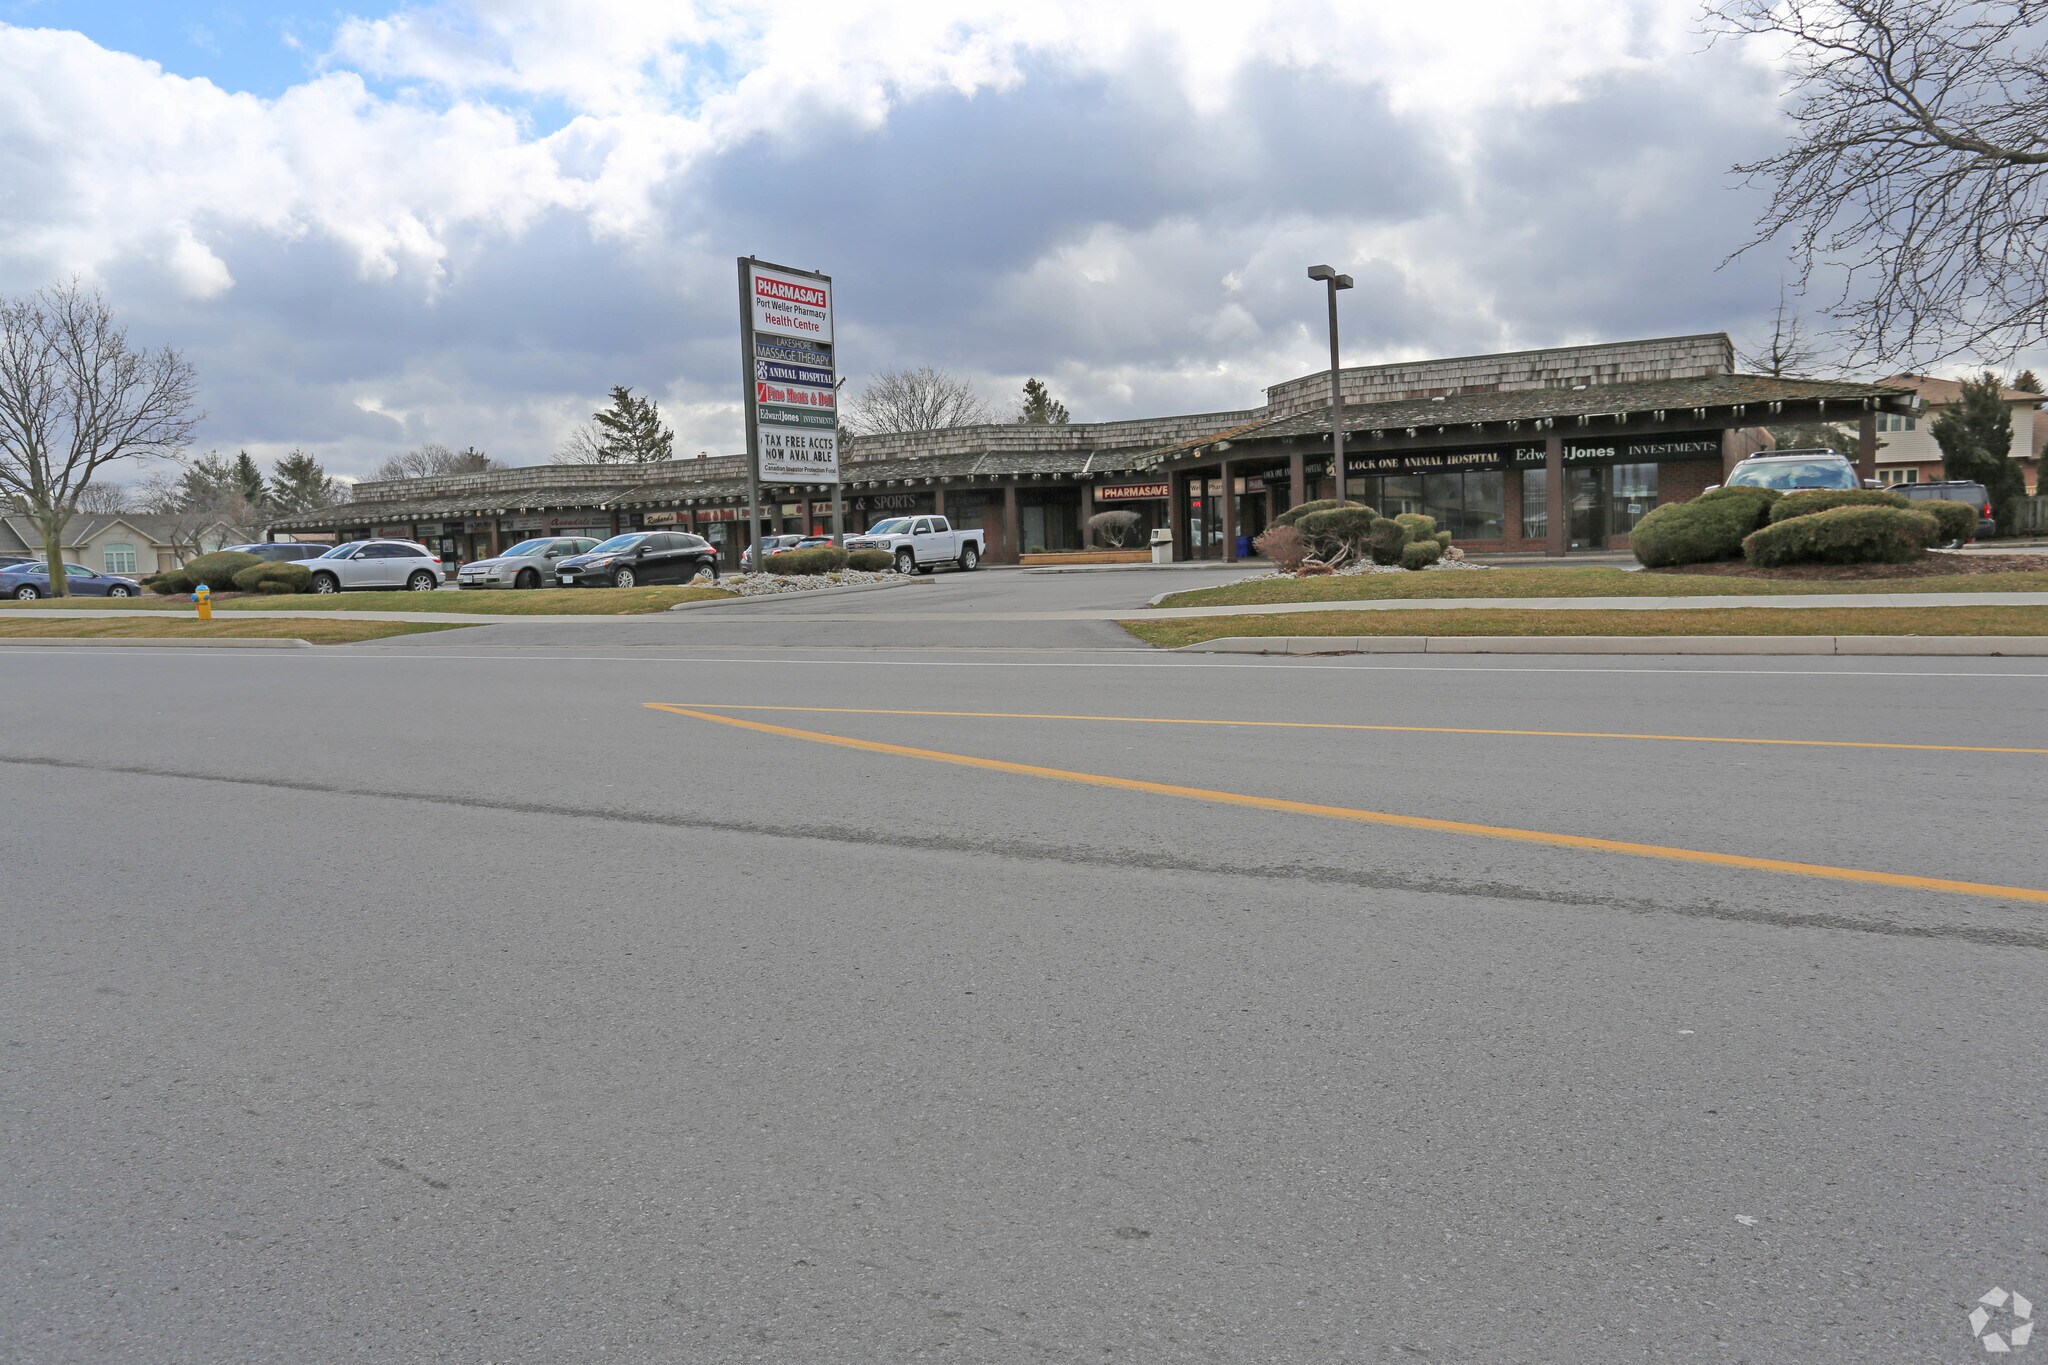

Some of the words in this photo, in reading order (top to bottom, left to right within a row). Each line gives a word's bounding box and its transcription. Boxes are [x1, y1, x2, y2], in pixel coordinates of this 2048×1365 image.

[757, 279, 824, 306] PHARMASAVE
[757, 297, 771, 309] Port
[771, 300, 793, 313] Weller
[794, 305, 827, 321] Pharmacy
[765, 312, 793, 328] Health
[793, 317, 820, 332] Centre
[776, 337, 812, 351] LAKESHORE
[757, 345, 796, 362] MASSAGE
[797, 351, 830, 366] THERAPY
[769, 366, 797, 380] ANIMAL
[799, 370, 833, 384] HOSPITAL
[767, 385, 786, 403] Fine
[786, 387, 809, 405] Meats
[811, 391, 817, 406] &
[818, 391, 835, 408] Deli
[803, 415, 834, 425] INVESTMENTS
[765, 434, 782, 447] TAX
[785, 436, 806, 448] FREE
[808, 437, 834, 450] ACCTS
[1628, 441, 1717, 456] INVESTMENTS
[765, 448, 785, 460] NOW
[1348, 460, 1376, 471] LOCK
[1378, 458, 1399, 469] ONE
[1404, 456, 1443, 467] ANIMAL
[1447, 452, 1500, 465] HOSPITAL
[764, 464, 786, 472] Canadian
[785, 465, 804, 473] Investor
[804, 466, 826, 474] Protection
[1104, 485, 1168, 498] PHARMASAVE
[855, 497, 866, 511] &
[874, 493, 916, 510] SPORTS
